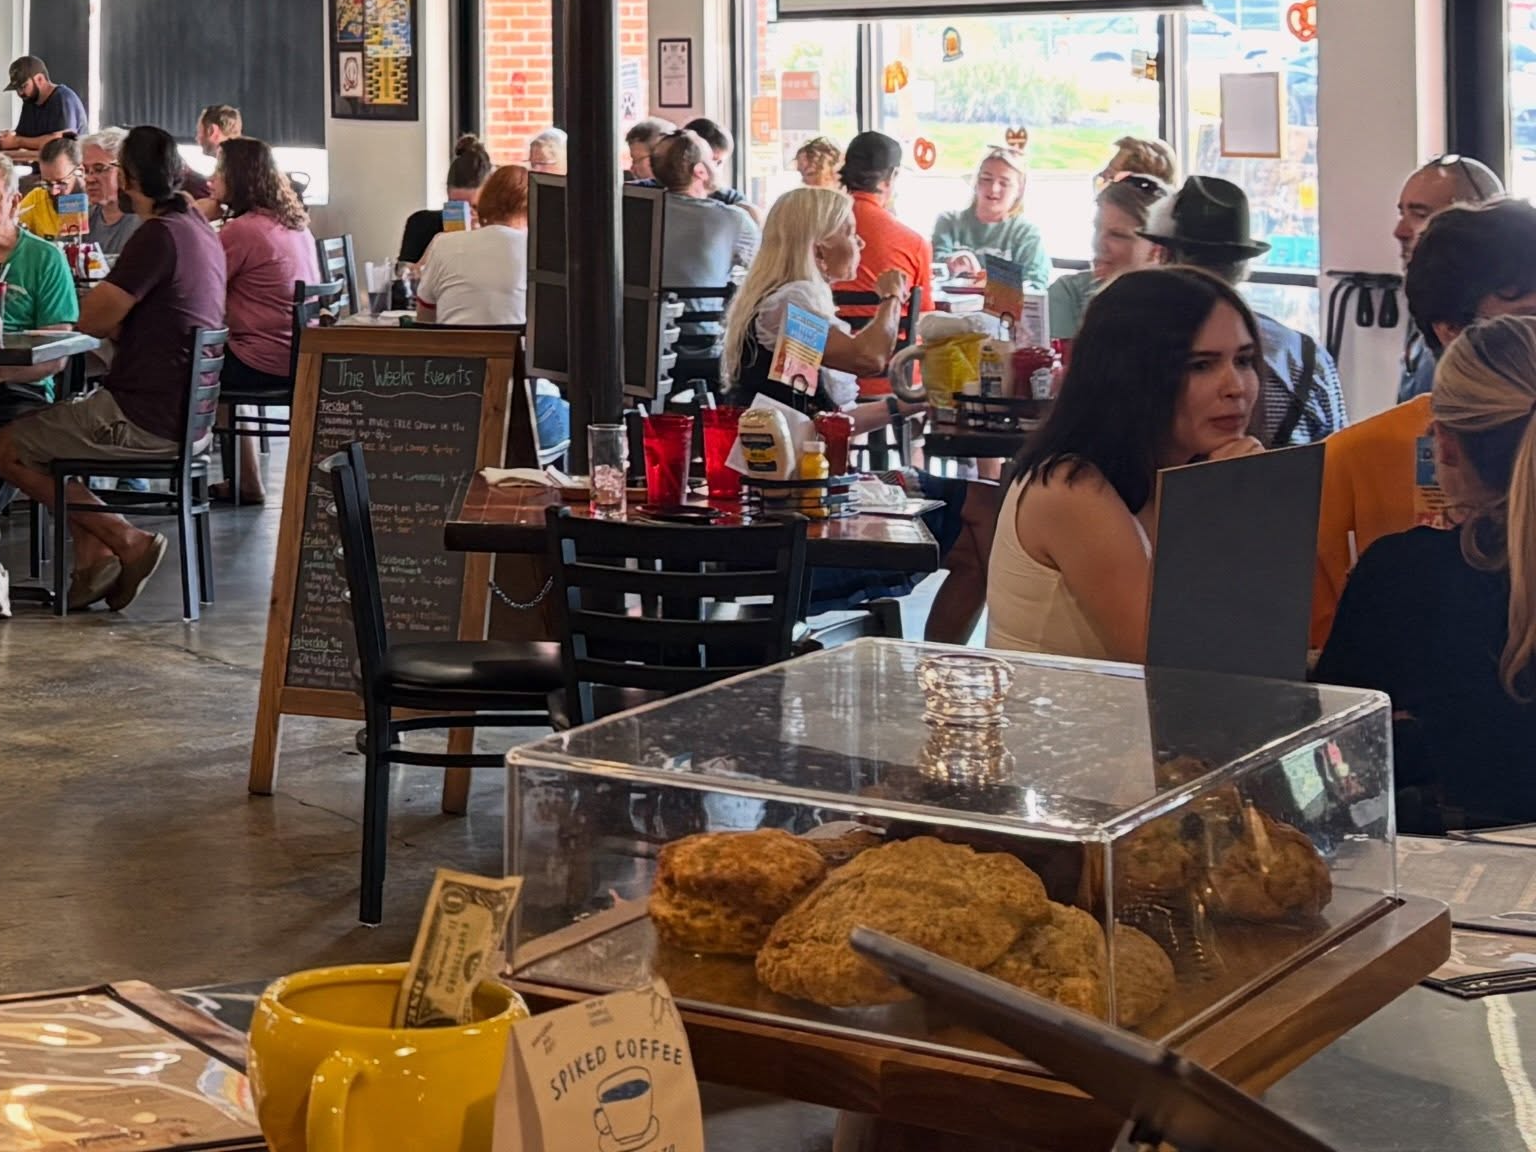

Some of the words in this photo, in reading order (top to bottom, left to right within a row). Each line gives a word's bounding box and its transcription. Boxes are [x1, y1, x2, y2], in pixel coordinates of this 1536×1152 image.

[327, 358, 364, 387] This
[372, 360, 415, 386] Weeks
[424, 359, 473, 386] Events
[320, 399, 350, 414] Tuesday
[550, 1045, 607, 1101] SPIKED
[616, 1038, 683, 1065] COFFEE
